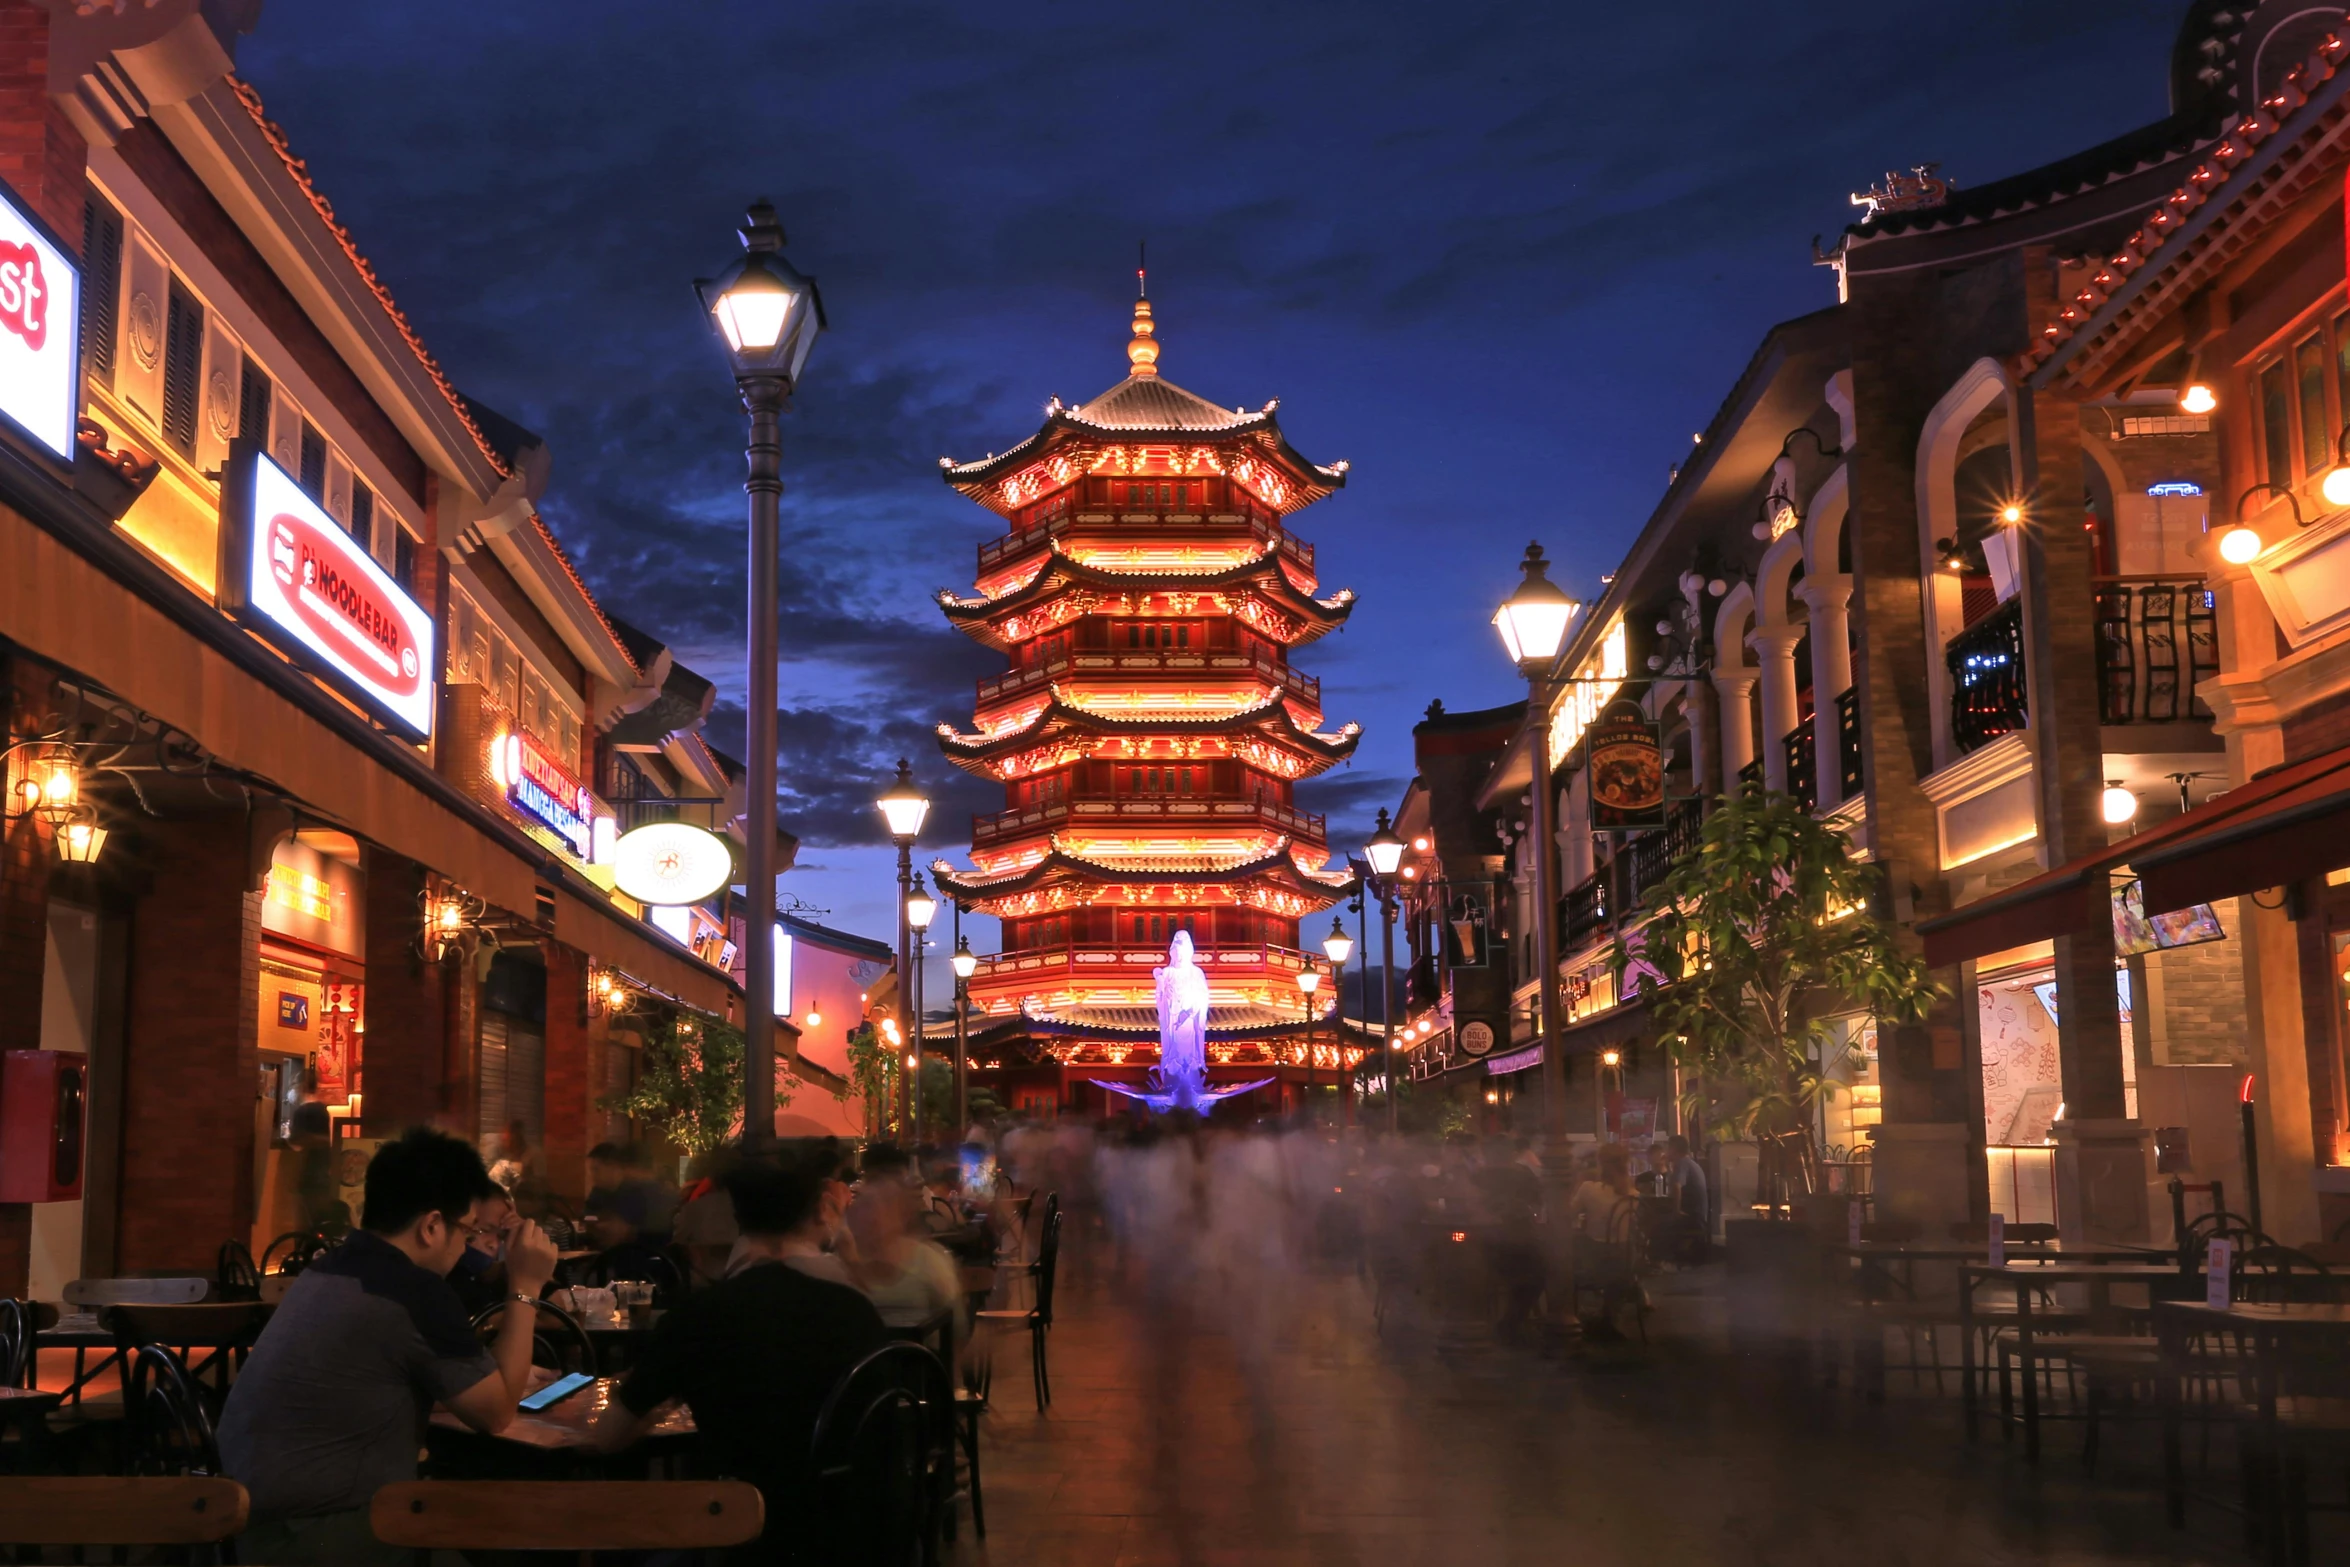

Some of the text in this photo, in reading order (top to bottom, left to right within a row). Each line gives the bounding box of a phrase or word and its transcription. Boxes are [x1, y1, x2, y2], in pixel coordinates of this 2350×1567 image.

[318, 559, 372, 633] NOODLE
[373, 609, 398, 655] BAR
[1614, 715, 1634, 723] THE
[1632, 733, 1656, 745] BOWL
[282, 1000, 296, 1010] PICK UP
[282, 1009, 291, 1018] HERE
[1467, 1031, 1487, 1040] BOLD
[1467, 1040, 1487, 1049] BUNS
